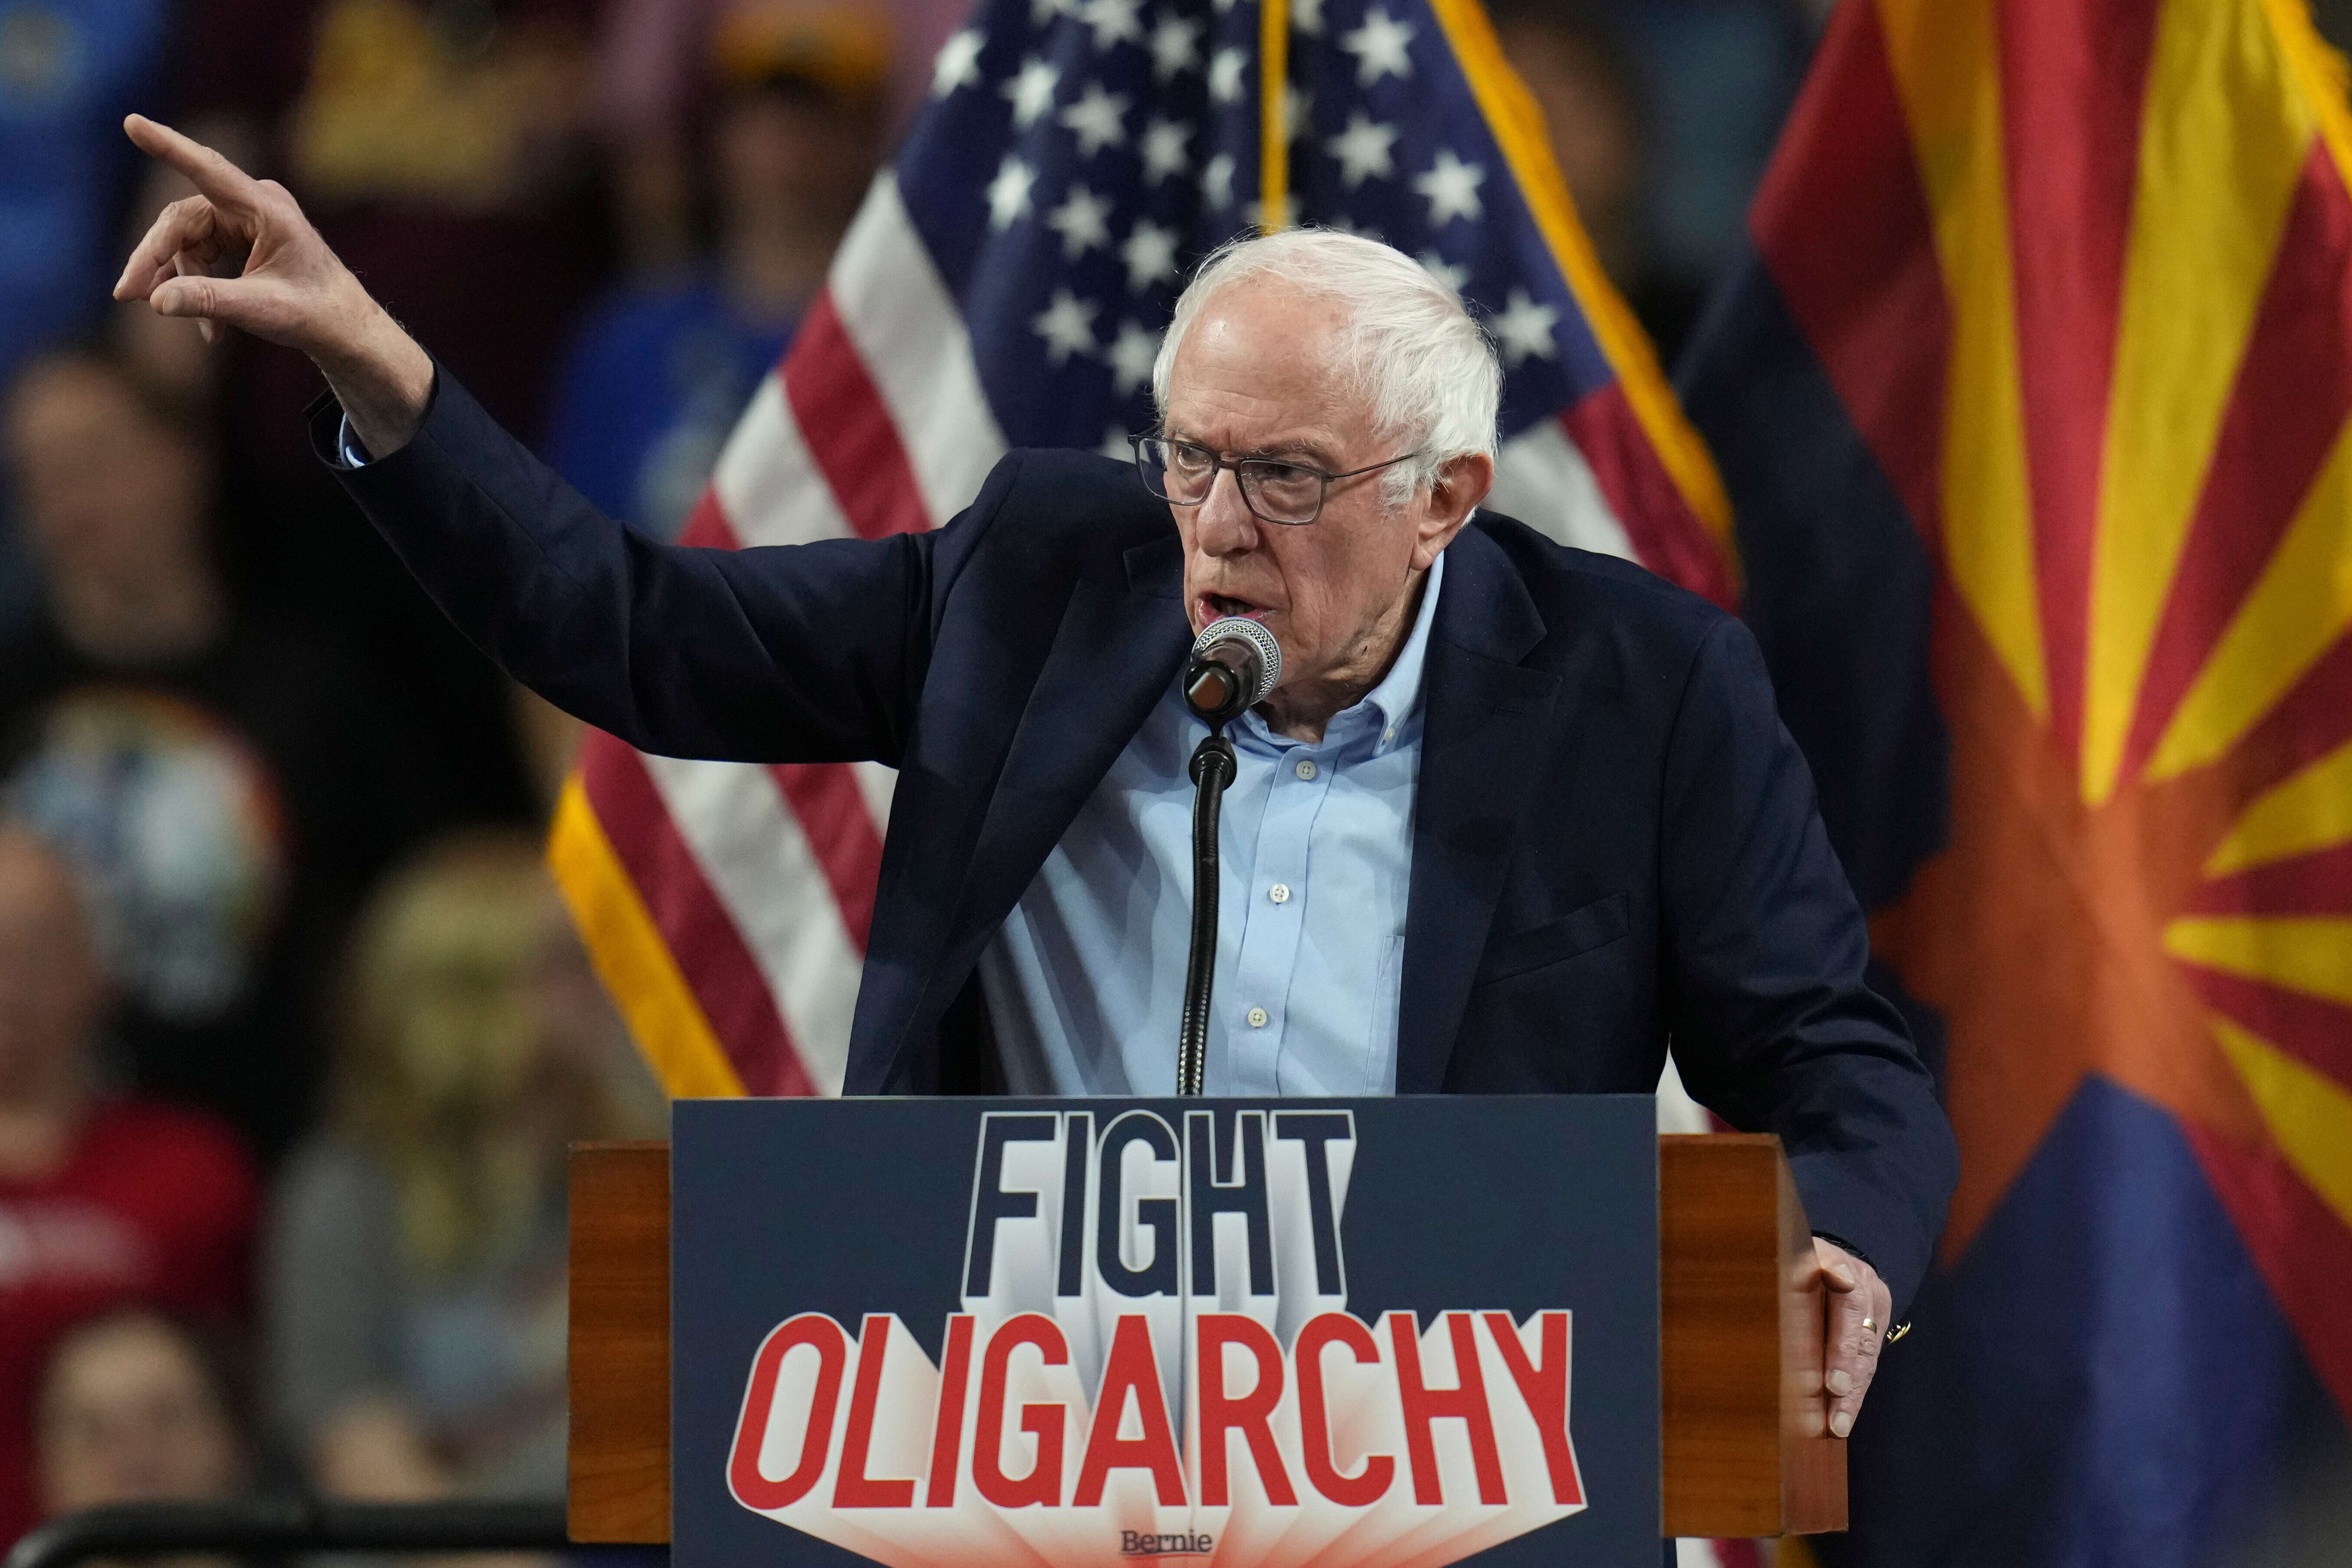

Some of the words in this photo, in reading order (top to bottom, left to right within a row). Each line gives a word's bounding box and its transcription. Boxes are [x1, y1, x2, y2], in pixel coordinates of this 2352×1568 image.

[962, 1110, 1357, 1298] FIGHT
[729, 1311, 1584, 1510] OLIGARCHY
[1121, 1529, 1213, 1554] Bernie
